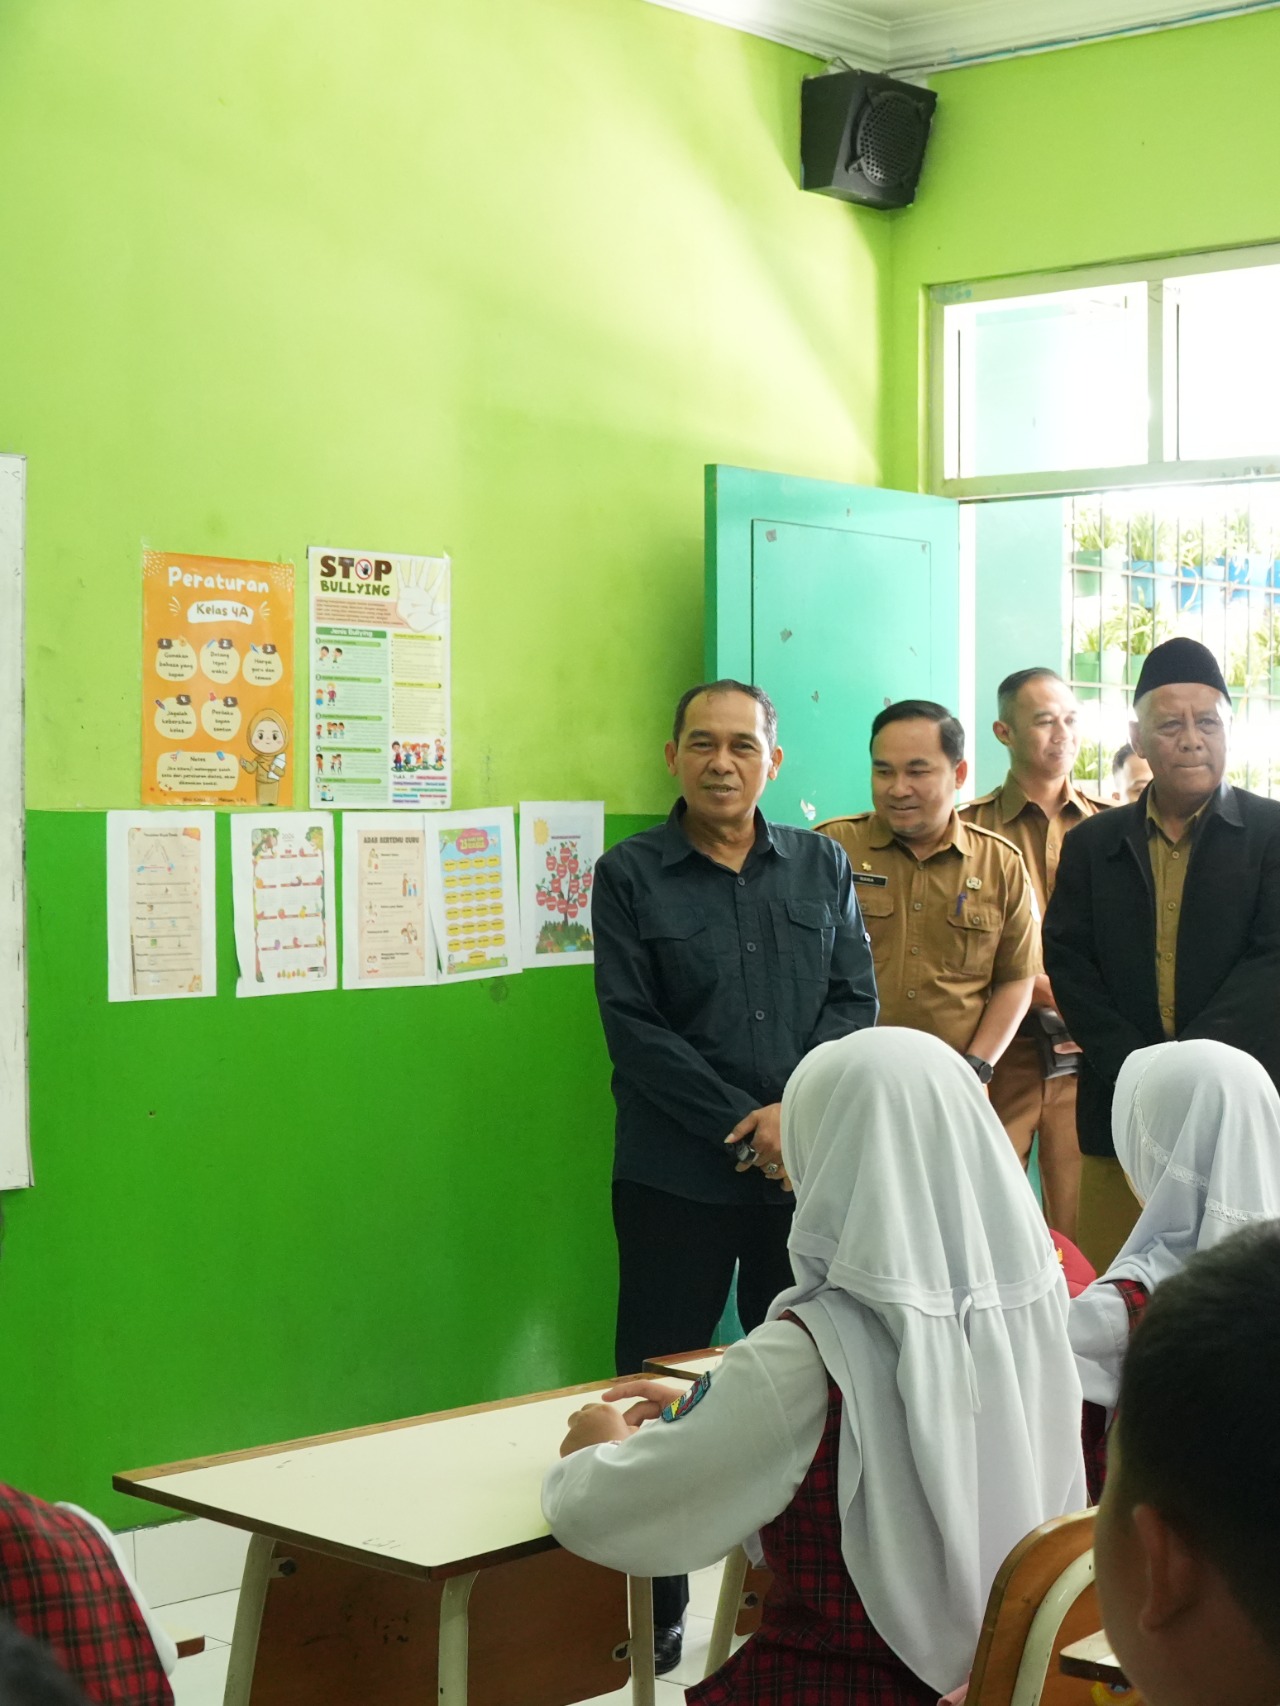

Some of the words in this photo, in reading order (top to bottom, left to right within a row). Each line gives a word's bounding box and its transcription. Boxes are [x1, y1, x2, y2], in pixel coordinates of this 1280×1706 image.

[320, 555, 392, 581] STOP
[167, 566, 269, 593] Peraturan
[320, 580, 390, 596] BULLYING
[196, 603, 228, 616] Kelas
[231, 606, 249, 618] 4A
